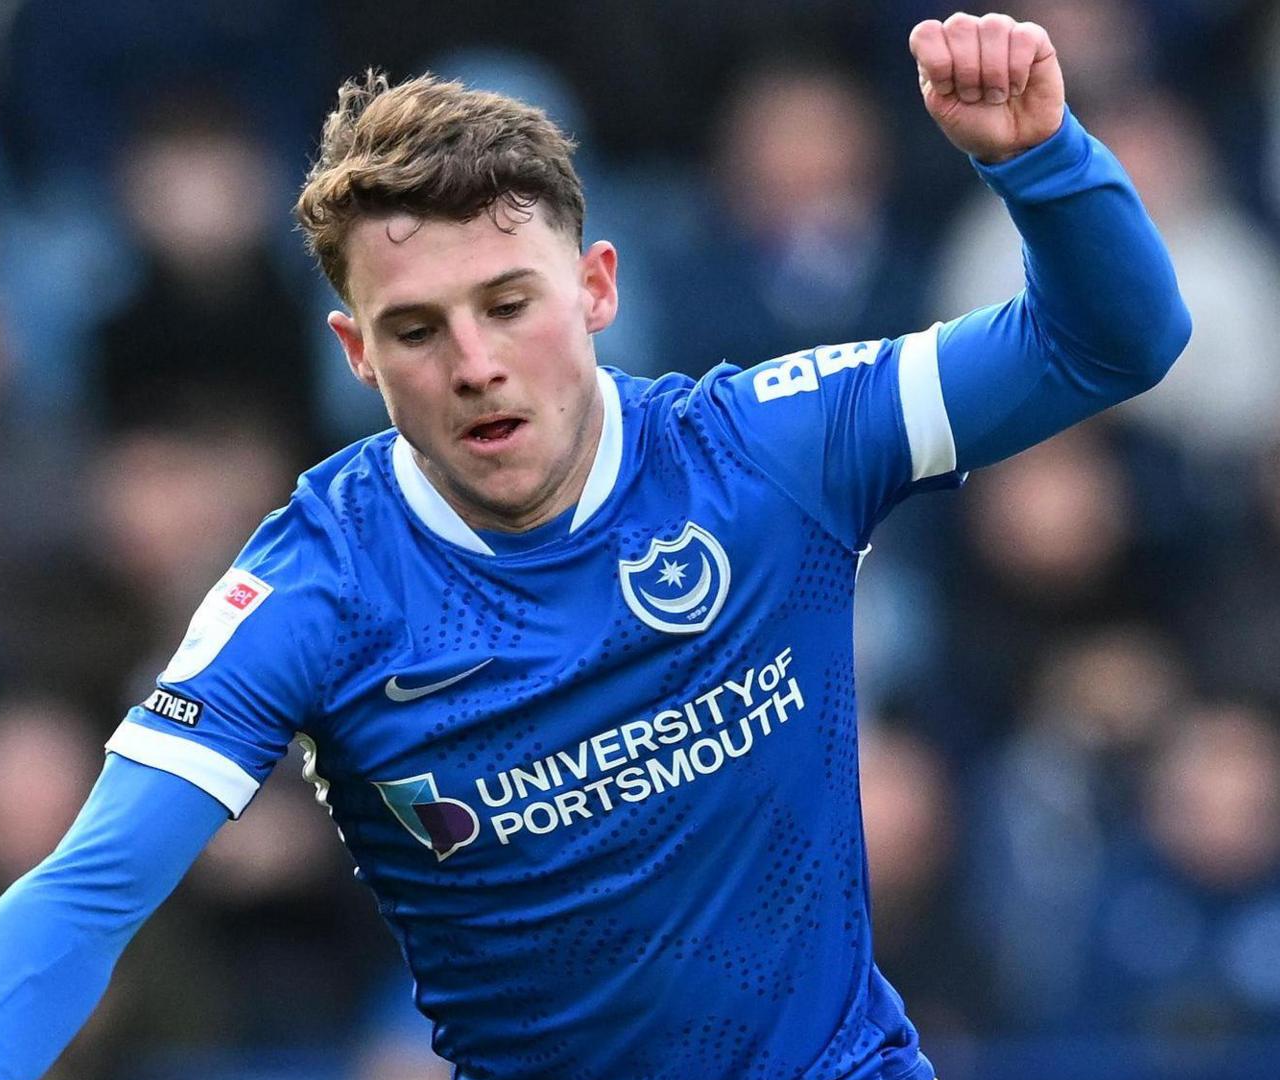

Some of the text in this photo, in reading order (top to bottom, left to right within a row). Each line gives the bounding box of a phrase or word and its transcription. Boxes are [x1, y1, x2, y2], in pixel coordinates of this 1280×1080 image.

[476, 647, 793, 807] UNIVERSITY OF
[490, 678, 805, 845] PORTSMOUTH
